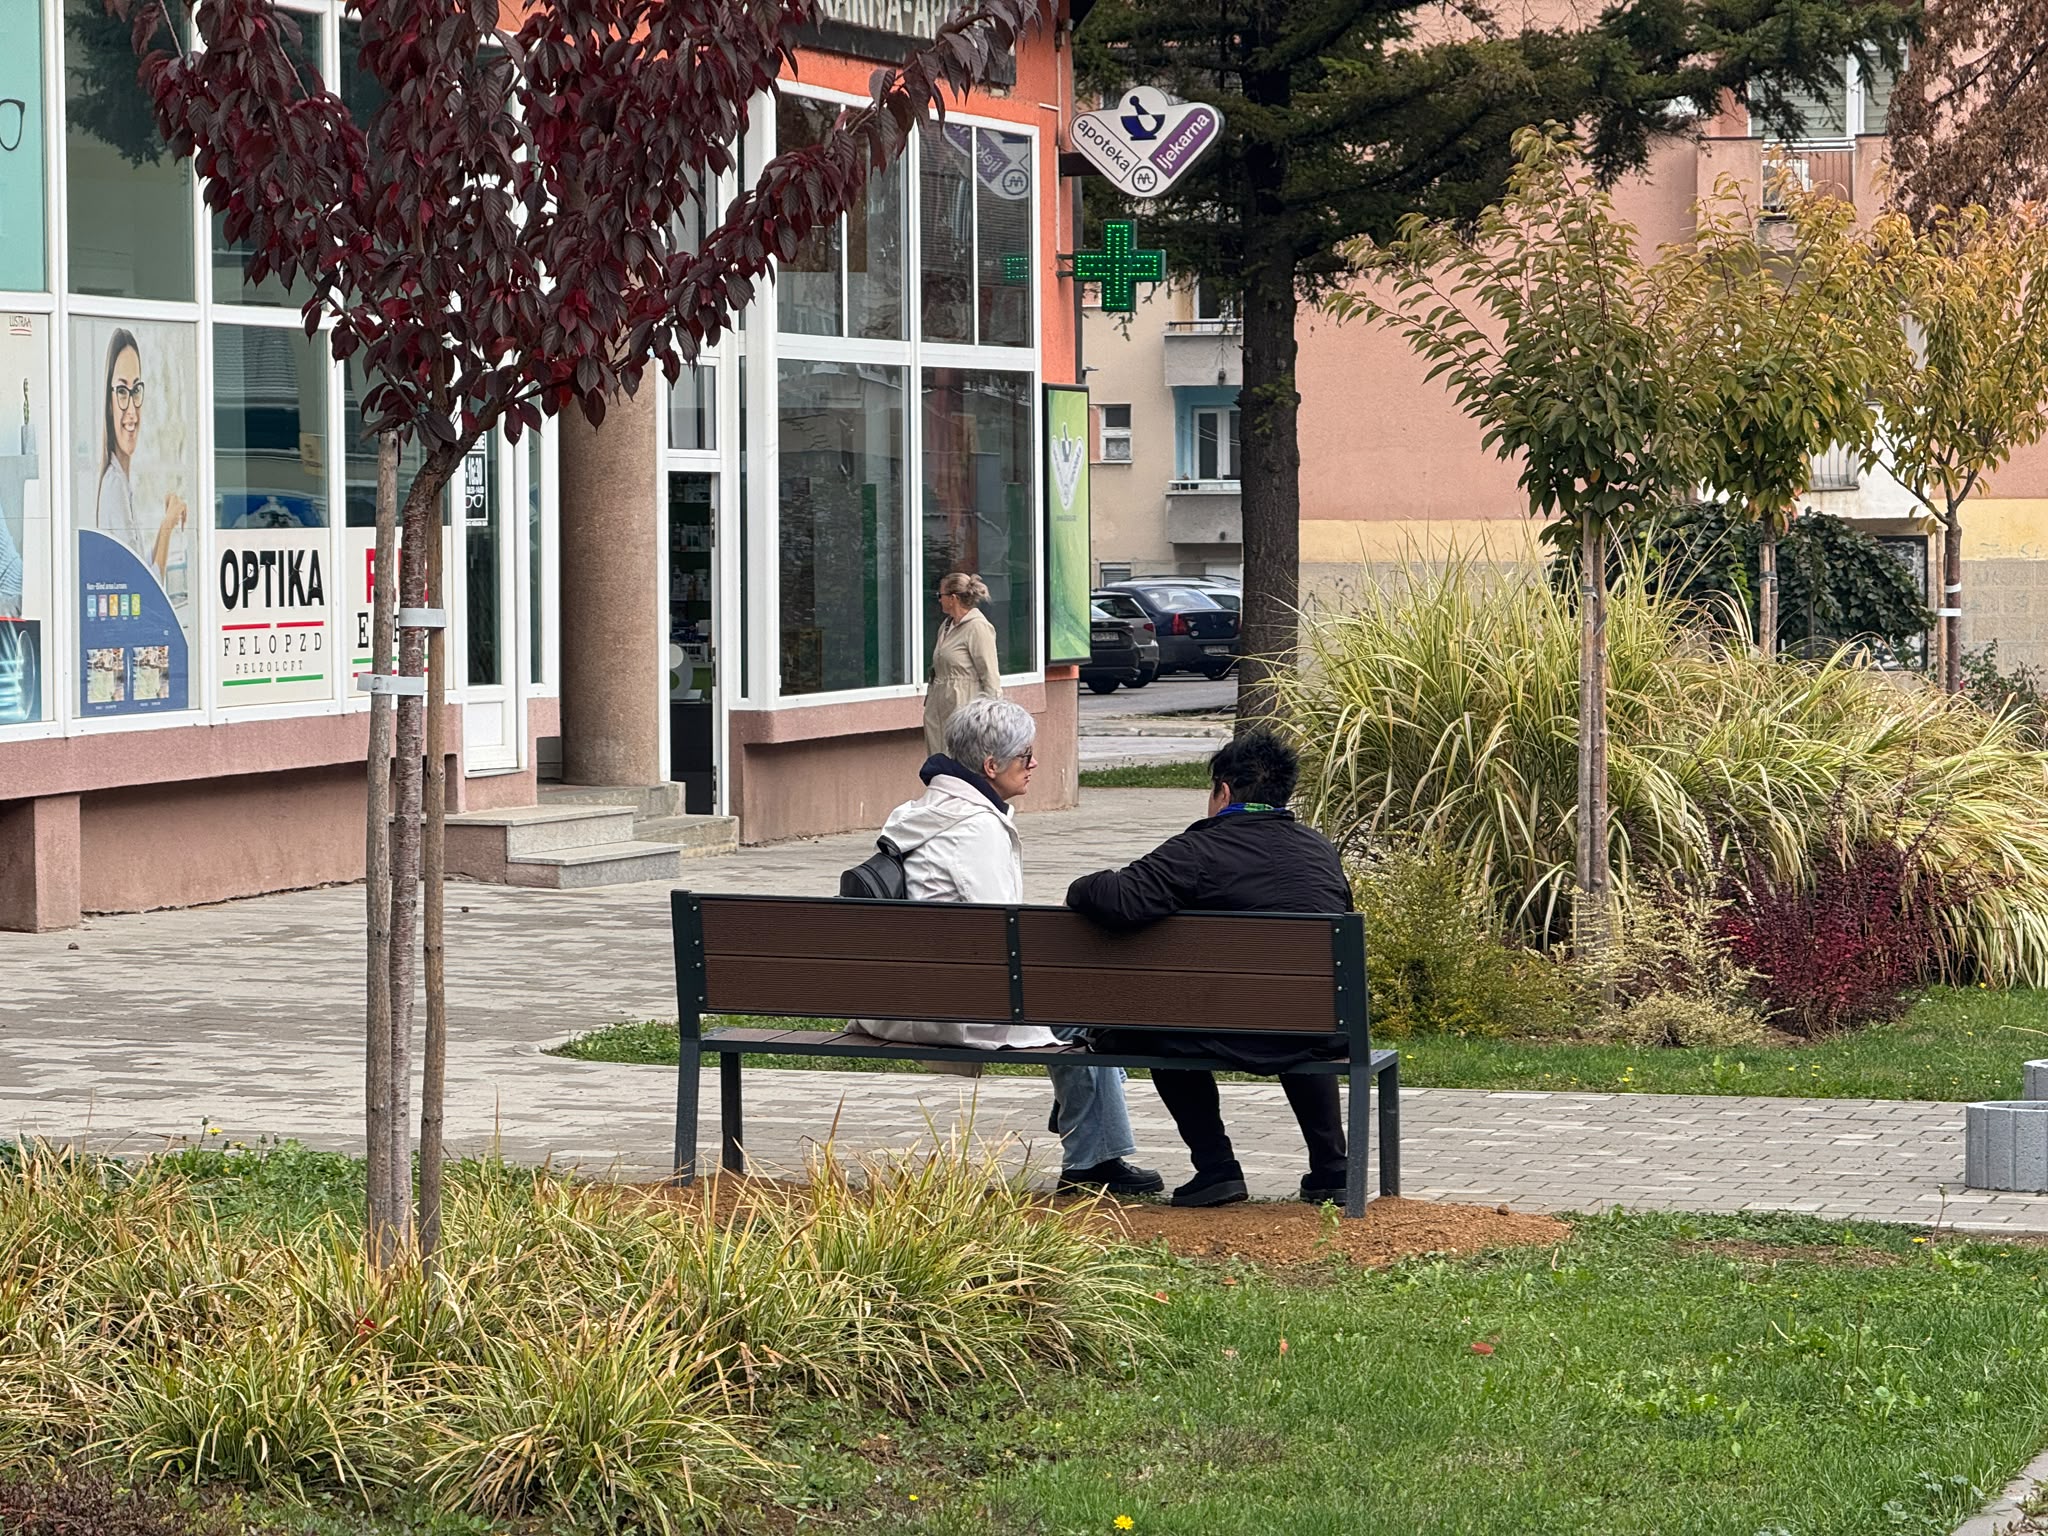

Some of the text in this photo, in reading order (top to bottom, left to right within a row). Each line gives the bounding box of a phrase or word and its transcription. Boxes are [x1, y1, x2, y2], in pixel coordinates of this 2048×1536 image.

[1077, 119, 1130, 172] apoteka
[1156, 114, 1210, 170] ljekarna
[220, 548, 325, 611] OPTIKA
[223, 632, 322, 657] FELOPZD
